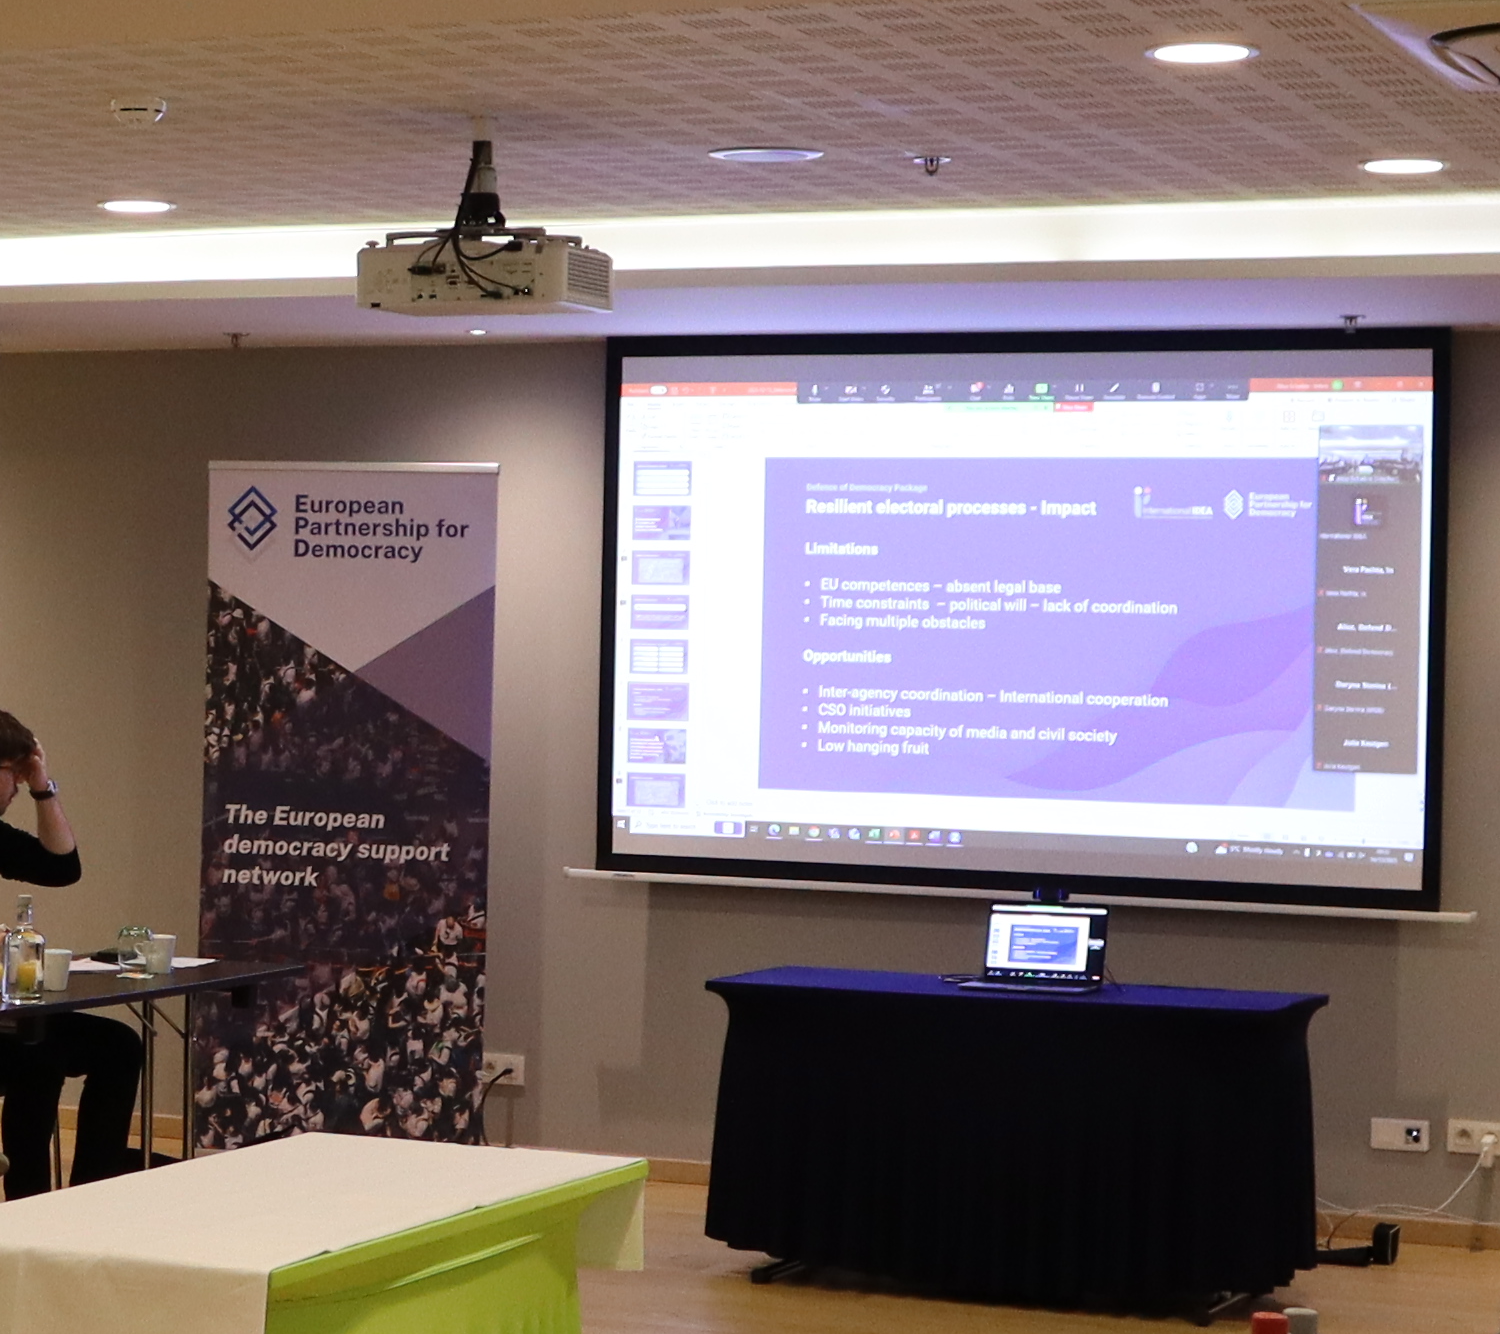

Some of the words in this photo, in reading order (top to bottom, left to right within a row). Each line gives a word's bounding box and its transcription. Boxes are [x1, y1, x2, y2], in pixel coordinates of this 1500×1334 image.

[806, 483, 838, 492] Defence
[840, 483, 848, 491] of
[849, 484, 893, 493] Democracy
[894, 484, 928, 493] Package
[1249, 492, 1290, 501] European
[295, 494, 404, 516] European
[805, 499, 873, 515] Resilient
[876, 499, 944, 515] electoral
[946, 501, 1027, 518] processes
[1040, 500, 1097, 518] Impact
[1191, 506, 1213, 515] IDEA
[1248, 508, 1297, 518] Democracy
[1249, 500, 1298, 510] Partnership
[1300, 500, 1312, 509] for
[294, 516, 430, 542] Partnership
[436, 520, 470, 538] for
[294, 539, 423, 563] Democracy
[805, 542, 879, 555] Limitations
[821, 578, 839, 591] EU
[841, 579, 930, 594] competences
[946, 580, 991, 593] absent
[994, 580, 1027, 596] legal
[1028, 581, 1062, 594] base
[820, 595, 853, 609] Time
[856, 597, 930, 610] constraints
[949, 598, 1001, 614] political
[1004, 598, 1027, 612] will
[1042, 599, 1071, 613] lack
[1074, 599, 1088, 613] of
[1091, 601, 1178, 615] coordination
[819, 614, 863, 629] Facing
[866, 615, 919, 630] multiple
[922, 616, 987, 629] obstacles
[803, 649, 892, 666] Opportunities
[818, 685, 898, 703] Inter-agency
[900, 687, 983, 703] coordination
[1000, 690, 1084, 706] International
[1086, 693, 1169, 709] cooperation
[818, 703, 846, 717] CSO
[849, 704, 911, 718] initiatives
[818, 722, 888, 738] Monitoring
[890, 723, 947, 741] capacity
[949, 725, 964, 739] of
[966, 726, 1007, 741] media
[1010, 727, 1036, 741] and
[1038, 728, 1065, 742] civil
[1068, 729, 1118, 746] society
[818, 739, 845, 753] Low
[847, 740, 900, 756] hanging
[902, 741, 930, 755] fruit
[224, 804, 268, 826] The
[272, 805, 385, 834] European
[223, 834, 353, 861] democracy
[356, 840, 450, 864] support
[222, 865, 319, 888] network
